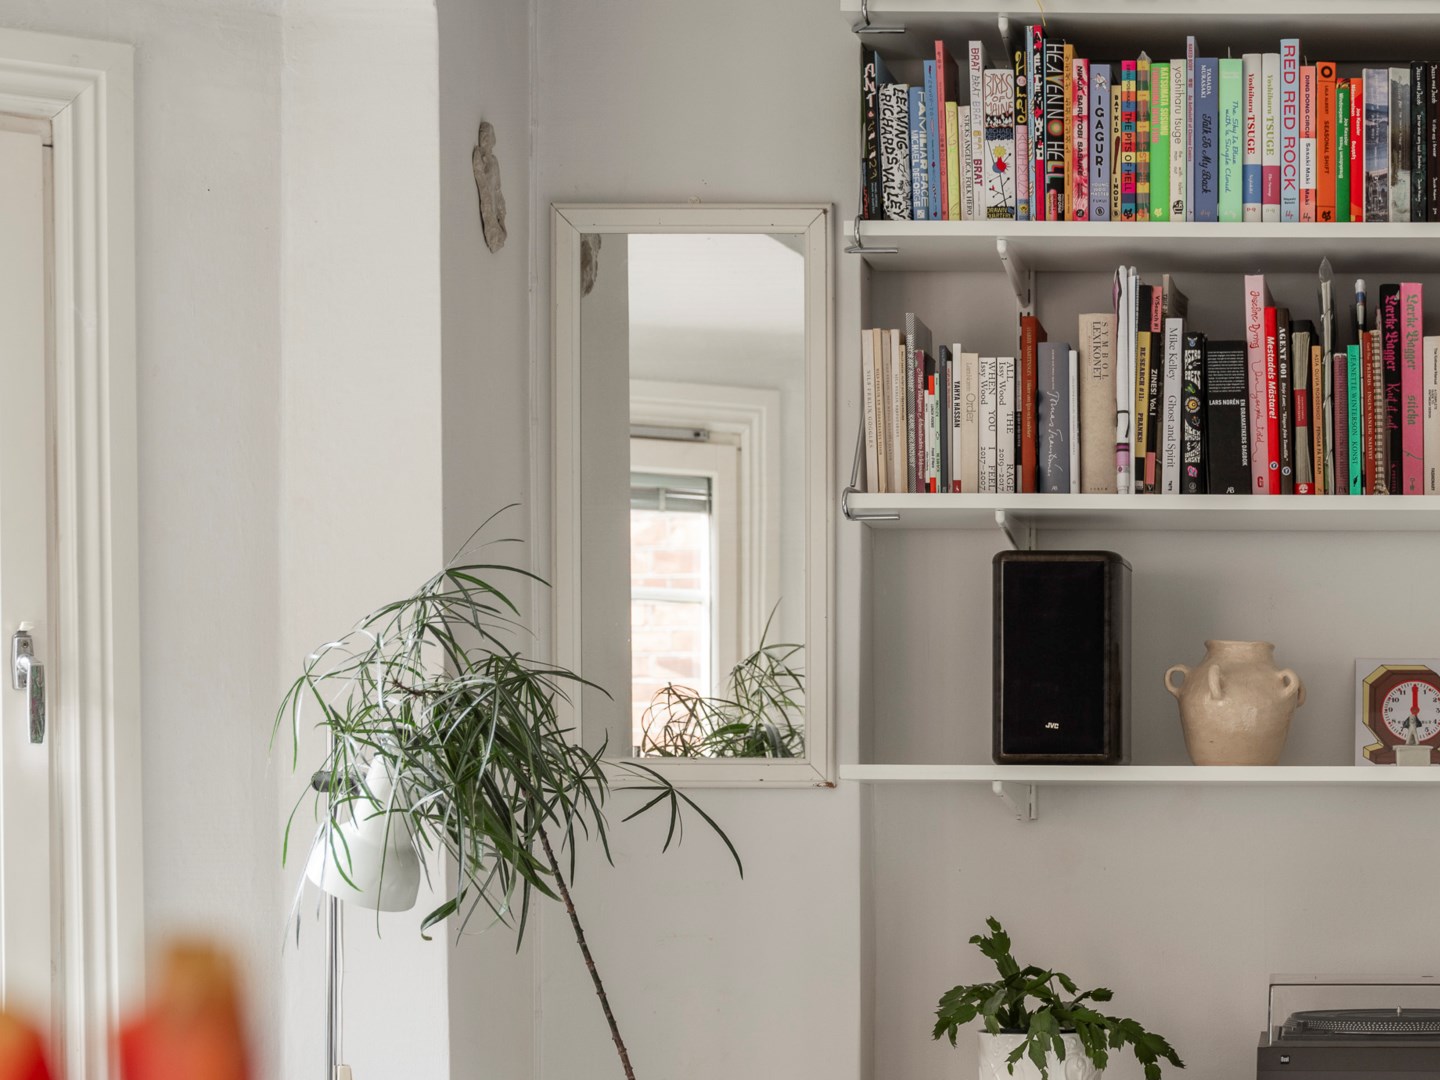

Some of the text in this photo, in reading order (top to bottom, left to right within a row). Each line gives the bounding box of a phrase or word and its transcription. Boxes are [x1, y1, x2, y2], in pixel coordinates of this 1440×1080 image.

[971, 48, 980, 70] BRAT
[1046, 44, 1063, 104] HEAVEN
[1172, 67, 1186, 144] yoshiharu tsuge
[1284, 45, 1296, 191] RED RED ROCK
[880, 88, 909, 219] LEAVING RICHARD'S VALLEY
[911, 130, 919, 165] MICHAEL
[918, 91, 928, 207] FAMILIAR FACE
[1095, 95, 1104, 178] IGAGURI
[1200, 114, 1211, 194] Talk To My Back
[1247, 115, 1255, 154] TSUGE
[1266, 116, 1274, 155] TSUGE
[974, 159, 982, 186] BRAT
[1046, 142, 1064, 183] HELL
[1125, 155, 1132, 167] OF
[980, 361, 988, 378] Issy
[998, 361, 1006, 378] Issy
[1093, 321, 1101, 380] LEXIKONET
[1405, 330, 1419, 370] Bagger
[1166, 328, 1178, 467] Mike Kelley Ghost and Spirit
[1267, 337, 1276, 419] Mestadels Mästare!
[1408, 395, 1418, 425] sticka
